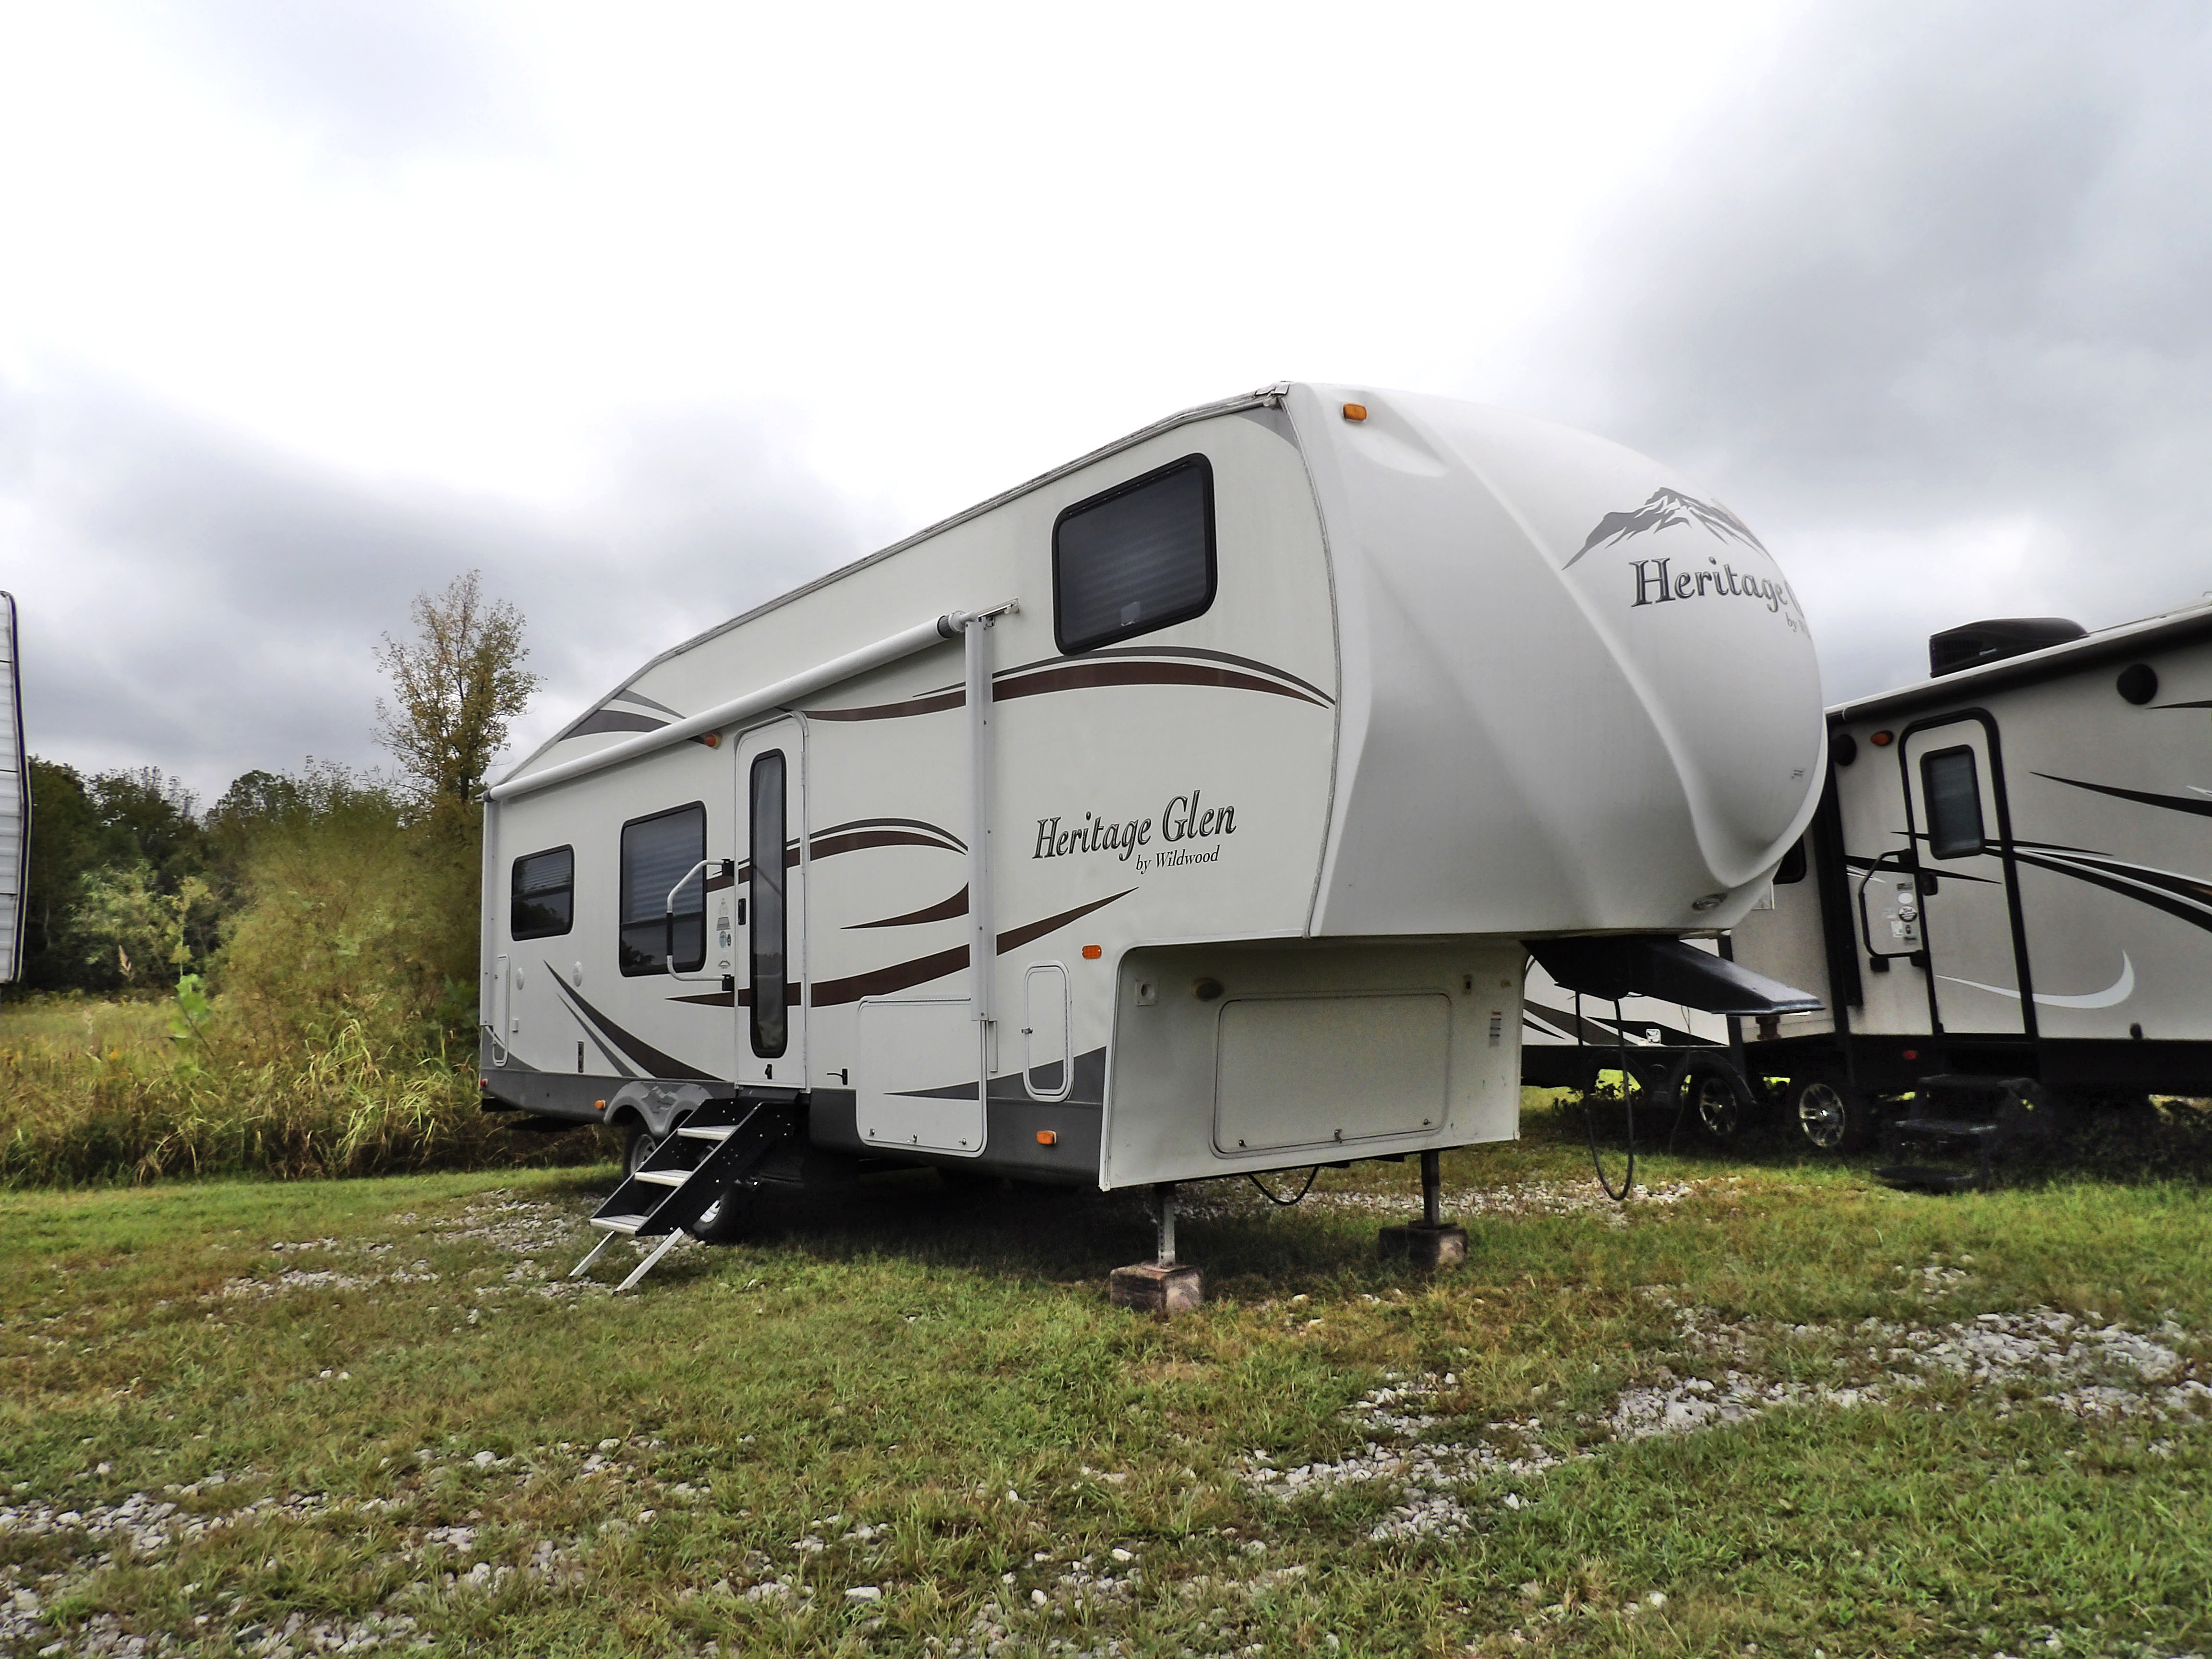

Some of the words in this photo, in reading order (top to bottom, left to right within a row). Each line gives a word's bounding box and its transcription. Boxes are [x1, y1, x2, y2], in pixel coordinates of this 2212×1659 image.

[1629, 556, 1787, 613] Heritage
[1032, 811, 1152, 861] Heritage
[1162, 788, 1237, 842] Glen
[1135, 854, 1152, 875] by
[1156, 844, 1221, 868] Wildwood
